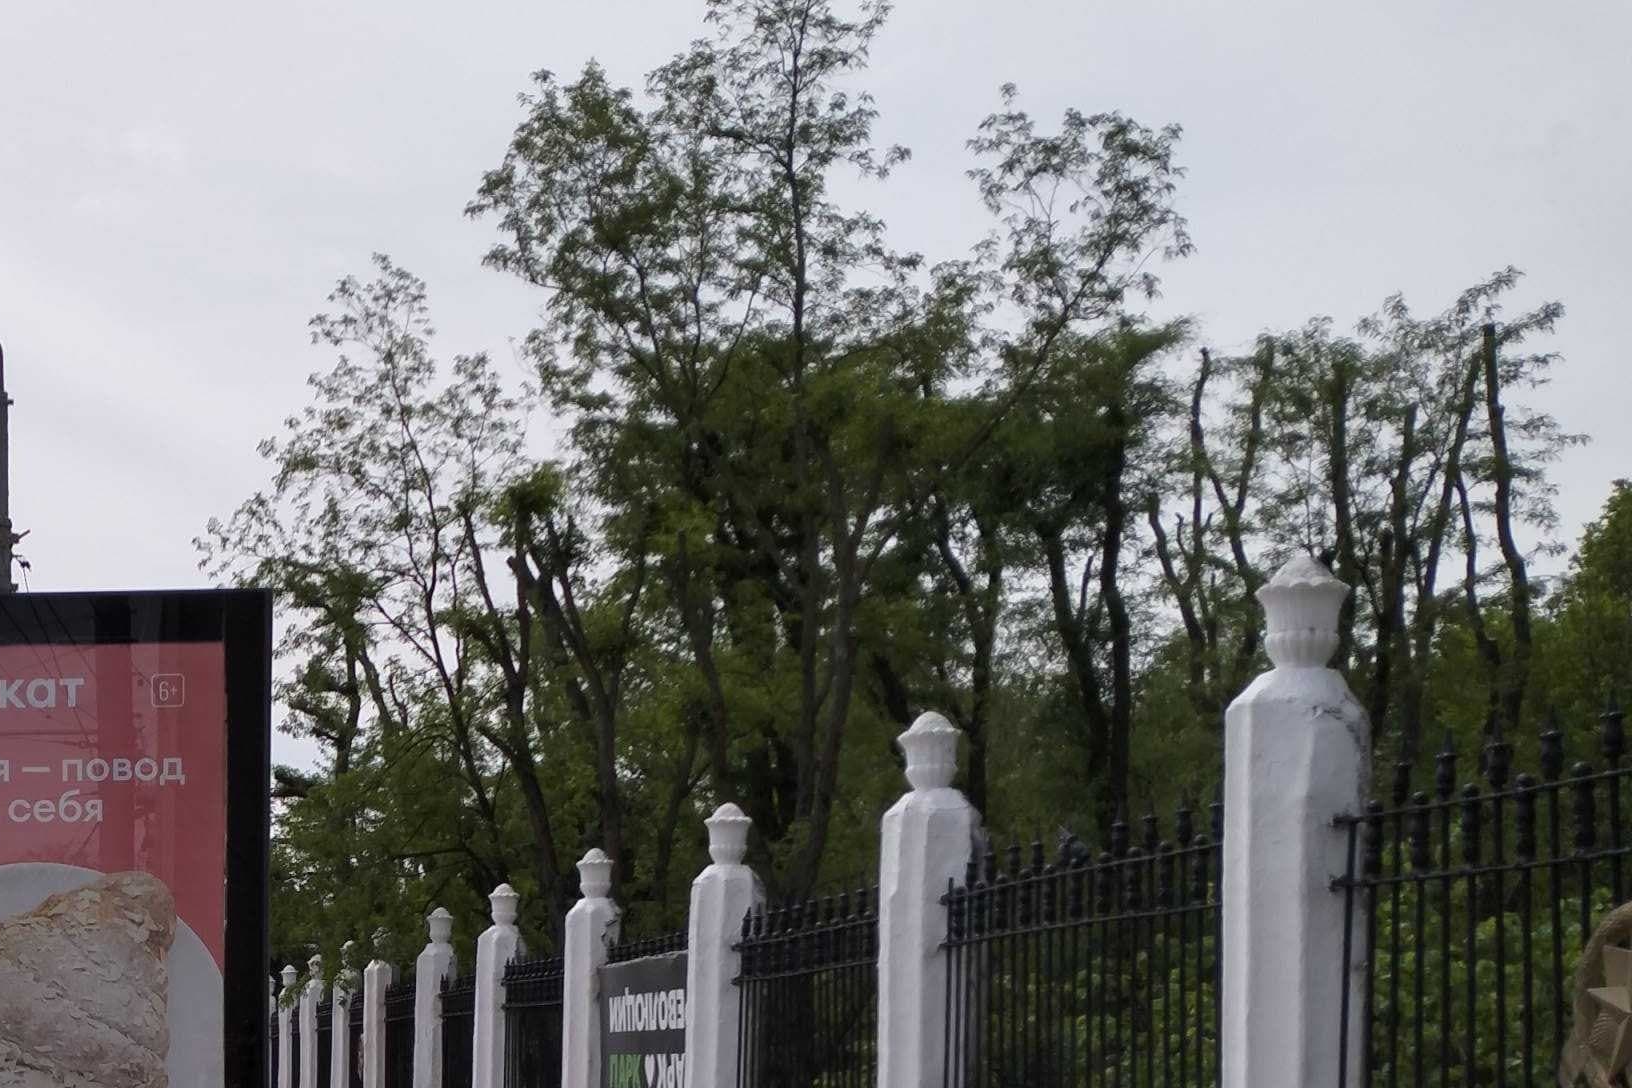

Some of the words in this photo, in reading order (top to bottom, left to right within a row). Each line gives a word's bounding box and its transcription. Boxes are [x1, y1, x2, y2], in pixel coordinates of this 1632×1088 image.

[158, 679, 180, 702] 6+
[62, 757, 186, 785] повод
[8, 788, 104, 824] себя
[609, 986, 686, 1034] ЕВОЛЮЦИИ
[609, 1054, 641, 1088] ПАРК
